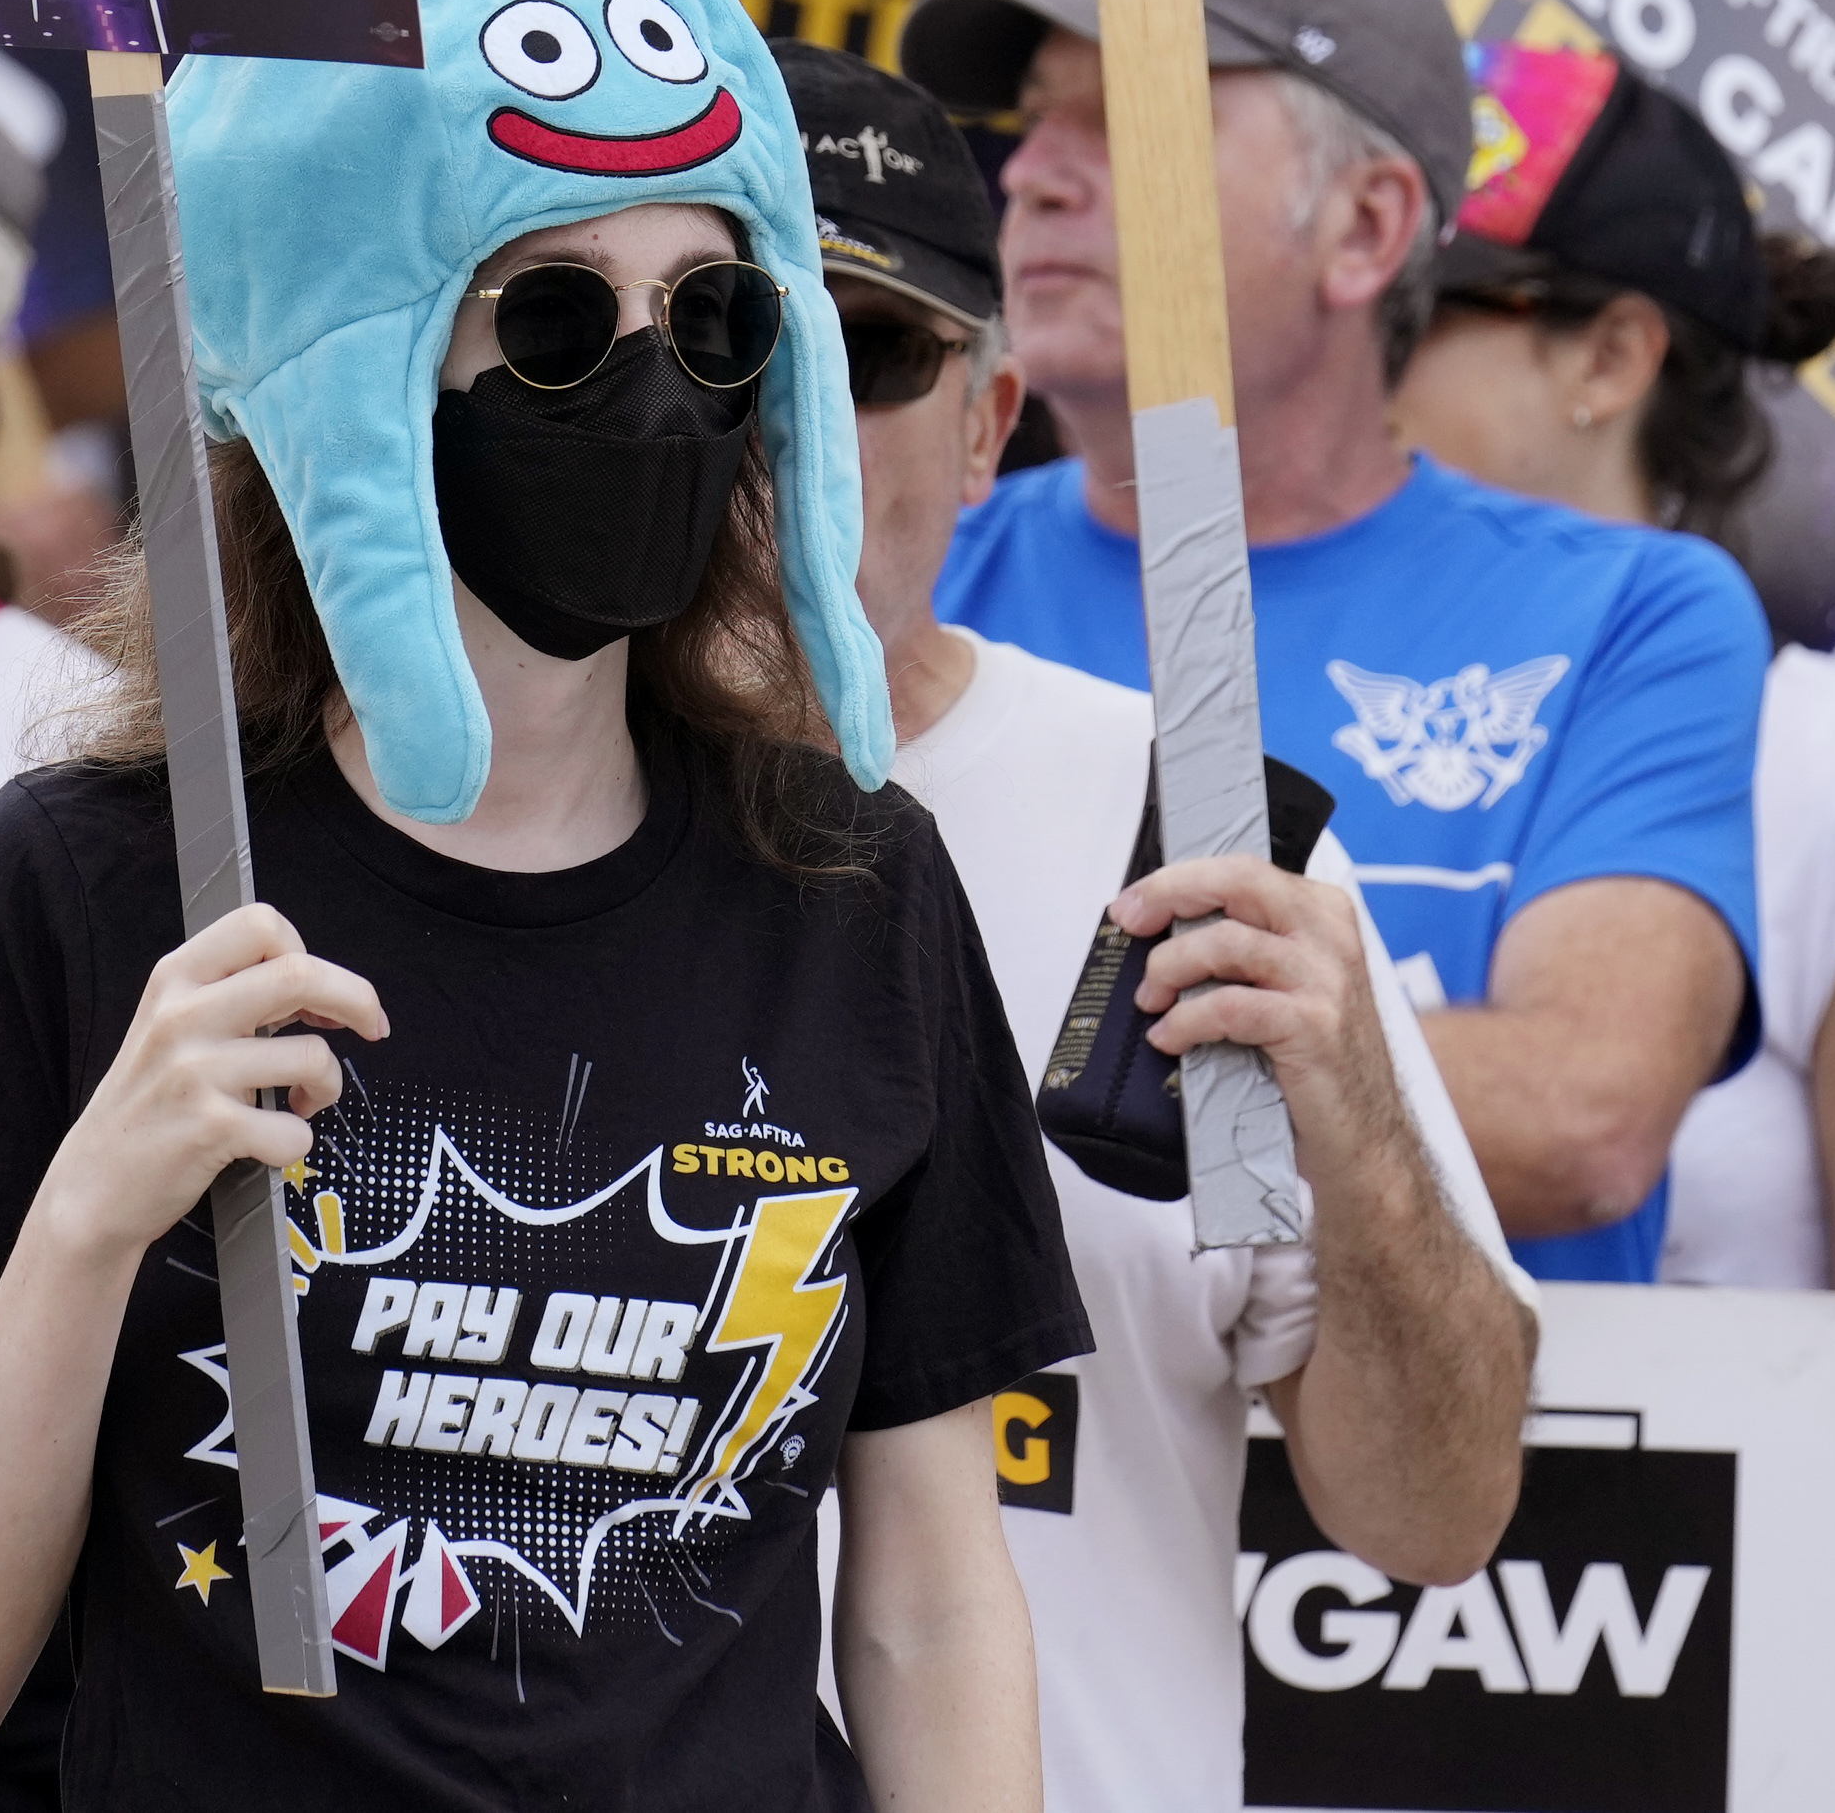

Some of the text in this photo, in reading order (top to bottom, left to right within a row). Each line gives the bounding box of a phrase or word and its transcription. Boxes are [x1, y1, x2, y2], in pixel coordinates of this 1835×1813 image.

[671, 1143, 850, 1185] STRONG
[352, 1276, 703, 1384] PAY OUR
[362, 1370, 704, 1478] HEROES!
[1233, 1549, 1713, 1698] GAW
